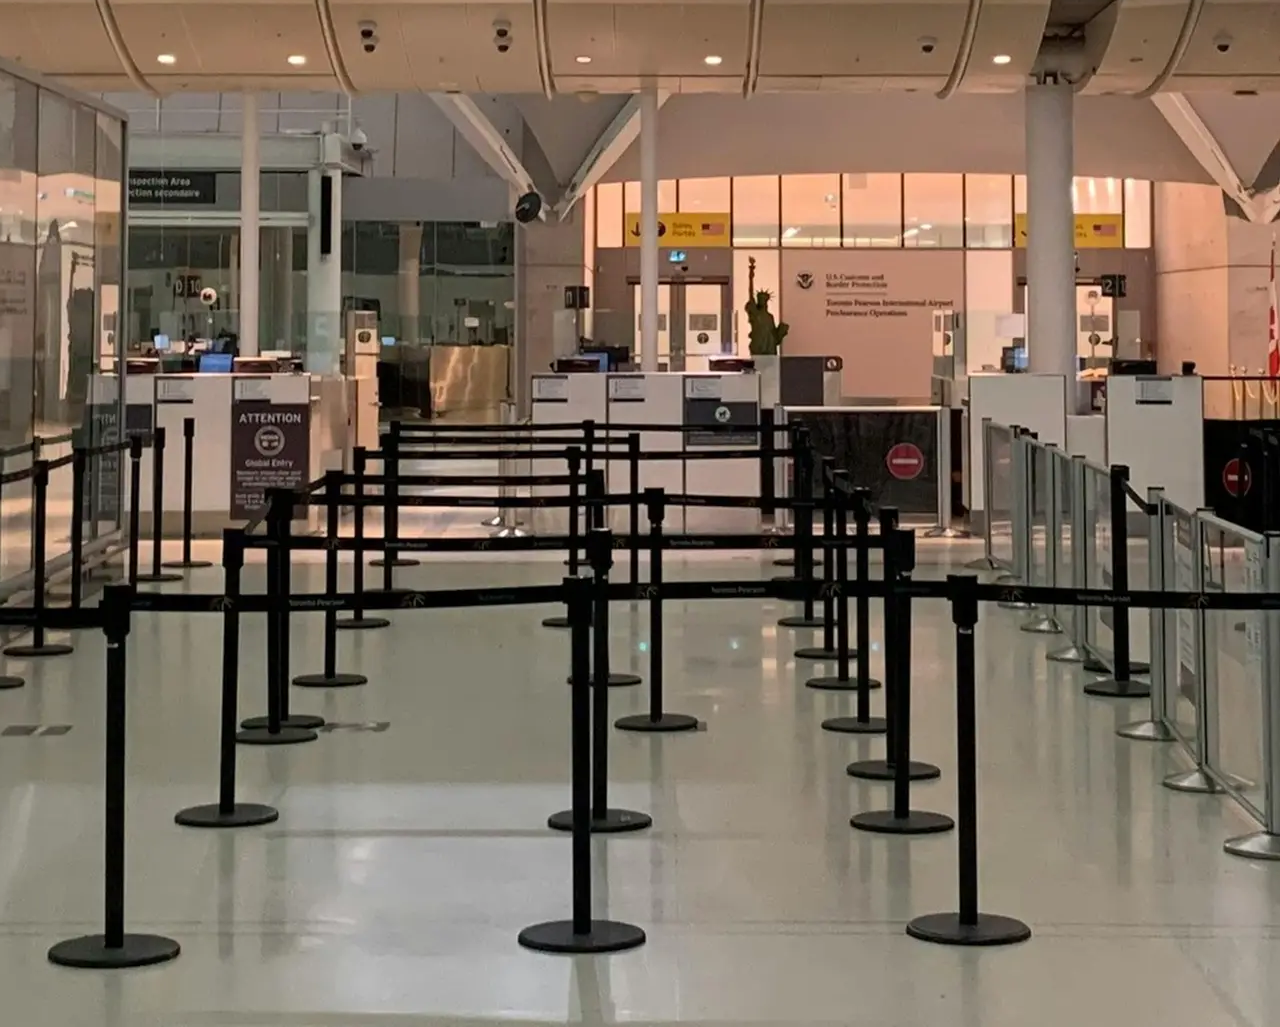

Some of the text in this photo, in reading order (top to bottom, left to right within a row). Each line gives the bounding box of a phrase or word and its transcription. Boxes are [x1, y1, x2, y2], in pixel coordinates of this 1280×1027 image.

[170, 177, 191, 187] Area
[826, 299, 954, 309] Toronto Pearson International Airport
[825, 309, 908, 318] Preclearance Operations
[238, 413, 302, 424] ATTENTION
[244, 459, 294, 468] Global Entry
